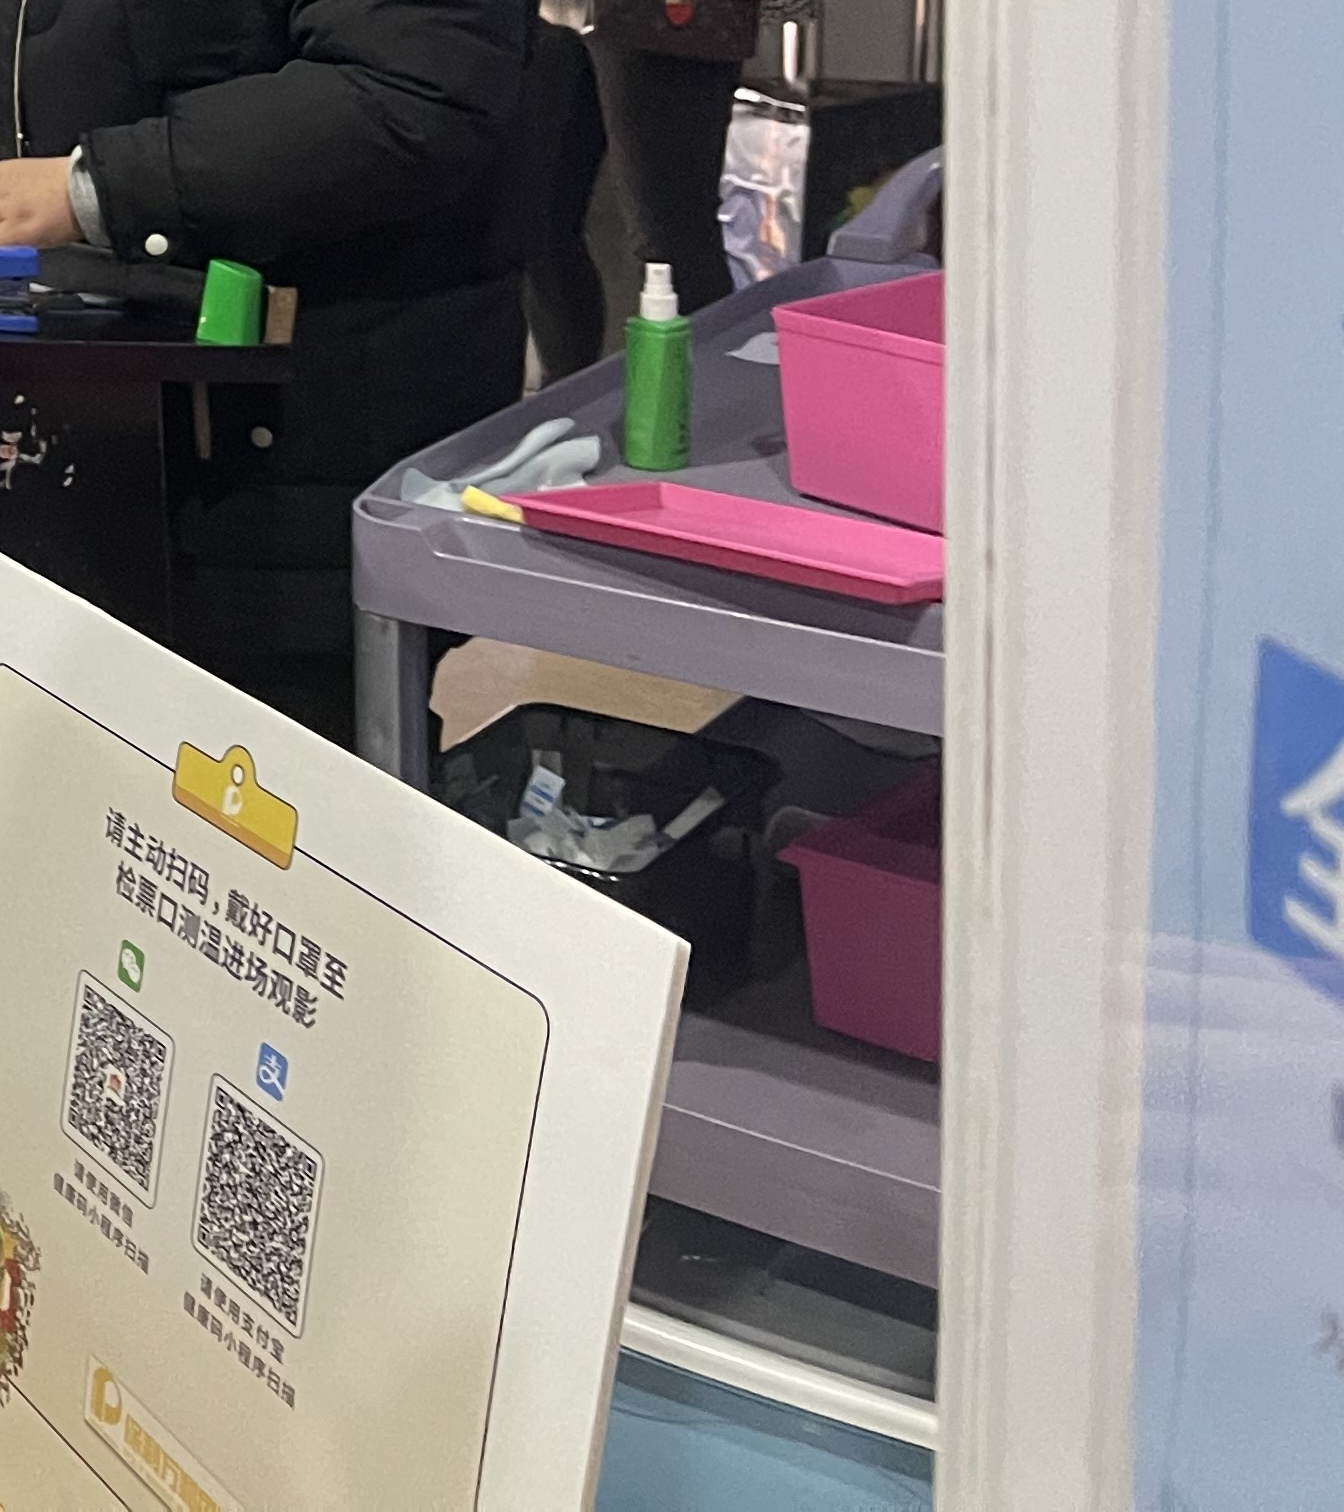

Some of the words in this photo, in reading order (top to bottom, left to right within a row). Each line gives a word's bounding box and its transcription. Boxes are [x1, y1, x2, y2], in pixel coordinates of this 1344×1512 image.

[116, 860, 317, 1029] 检票口测温进场观影
